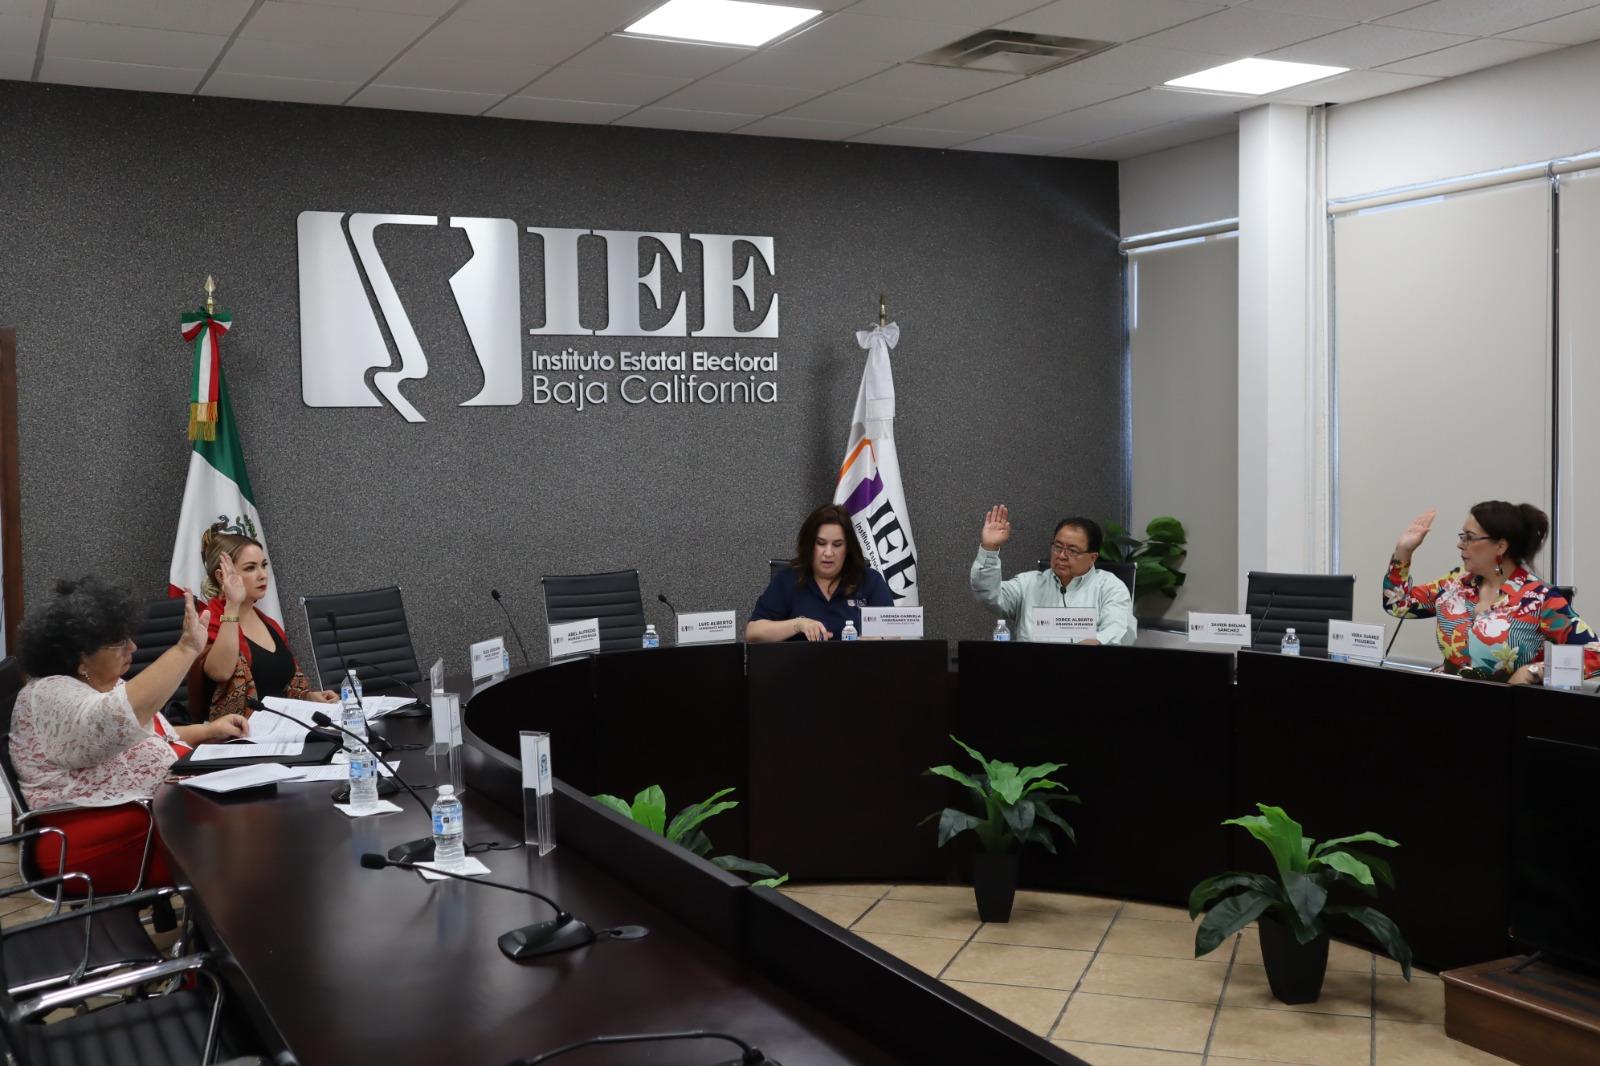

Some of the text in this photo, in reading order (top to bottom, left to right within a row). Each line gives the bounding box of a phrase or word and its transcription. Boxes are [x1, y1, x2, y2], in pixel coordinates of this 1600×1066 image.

[527, 226, 779, 338] IEE
[532, 349, 778, 372] Instituto Estatal Electoral
[533, 375, 778, 411] Baja California
